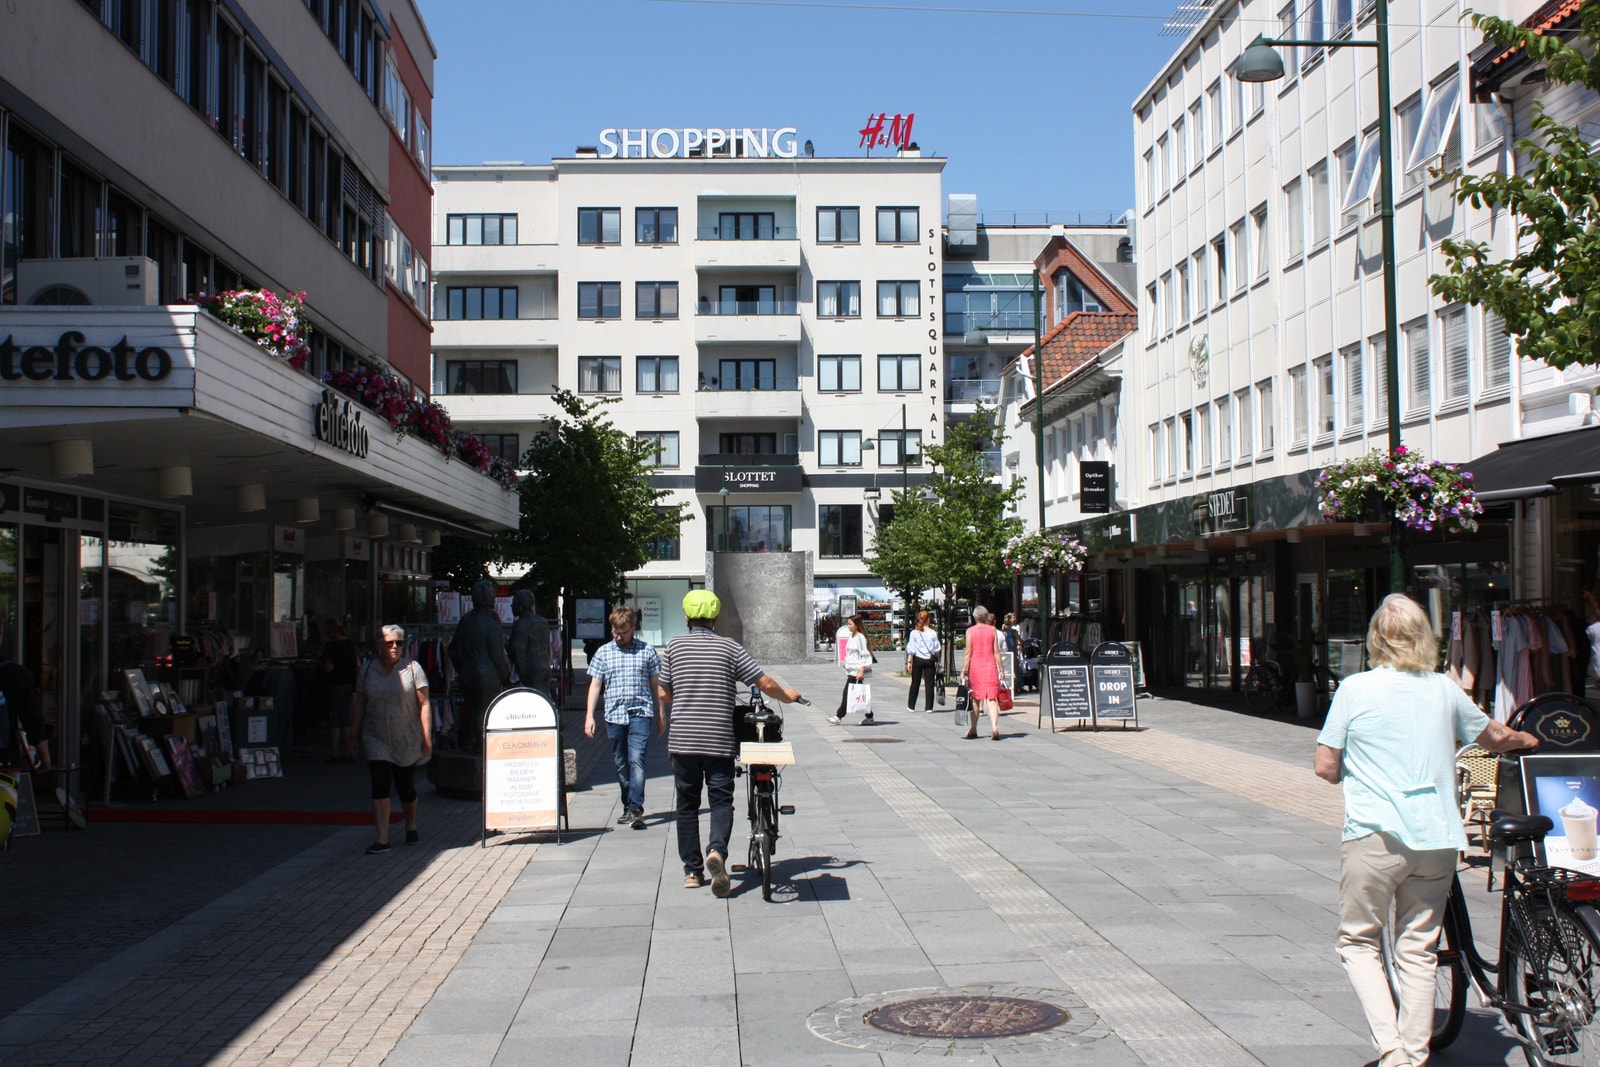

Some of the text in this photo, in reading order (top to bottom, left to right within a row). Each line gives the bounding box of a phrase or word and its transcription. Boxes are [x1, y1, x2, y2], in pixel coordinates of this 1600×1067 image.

[858, 112, 915, 149] H&M
[598, 127, 798, 159] SHOPPING
[315, 390, 370, 459] elitefoto
[724, 471, 777, 482] SLOTTET
[1084, 472, 1104, 480] Optiker
[1208, 490, 1236, 518] STEDET
[1099, 682, 1127, 691] DROP
[1108, 695, 1120, 705] IN
[497, 741, 547, 749] VELKOMMEN
